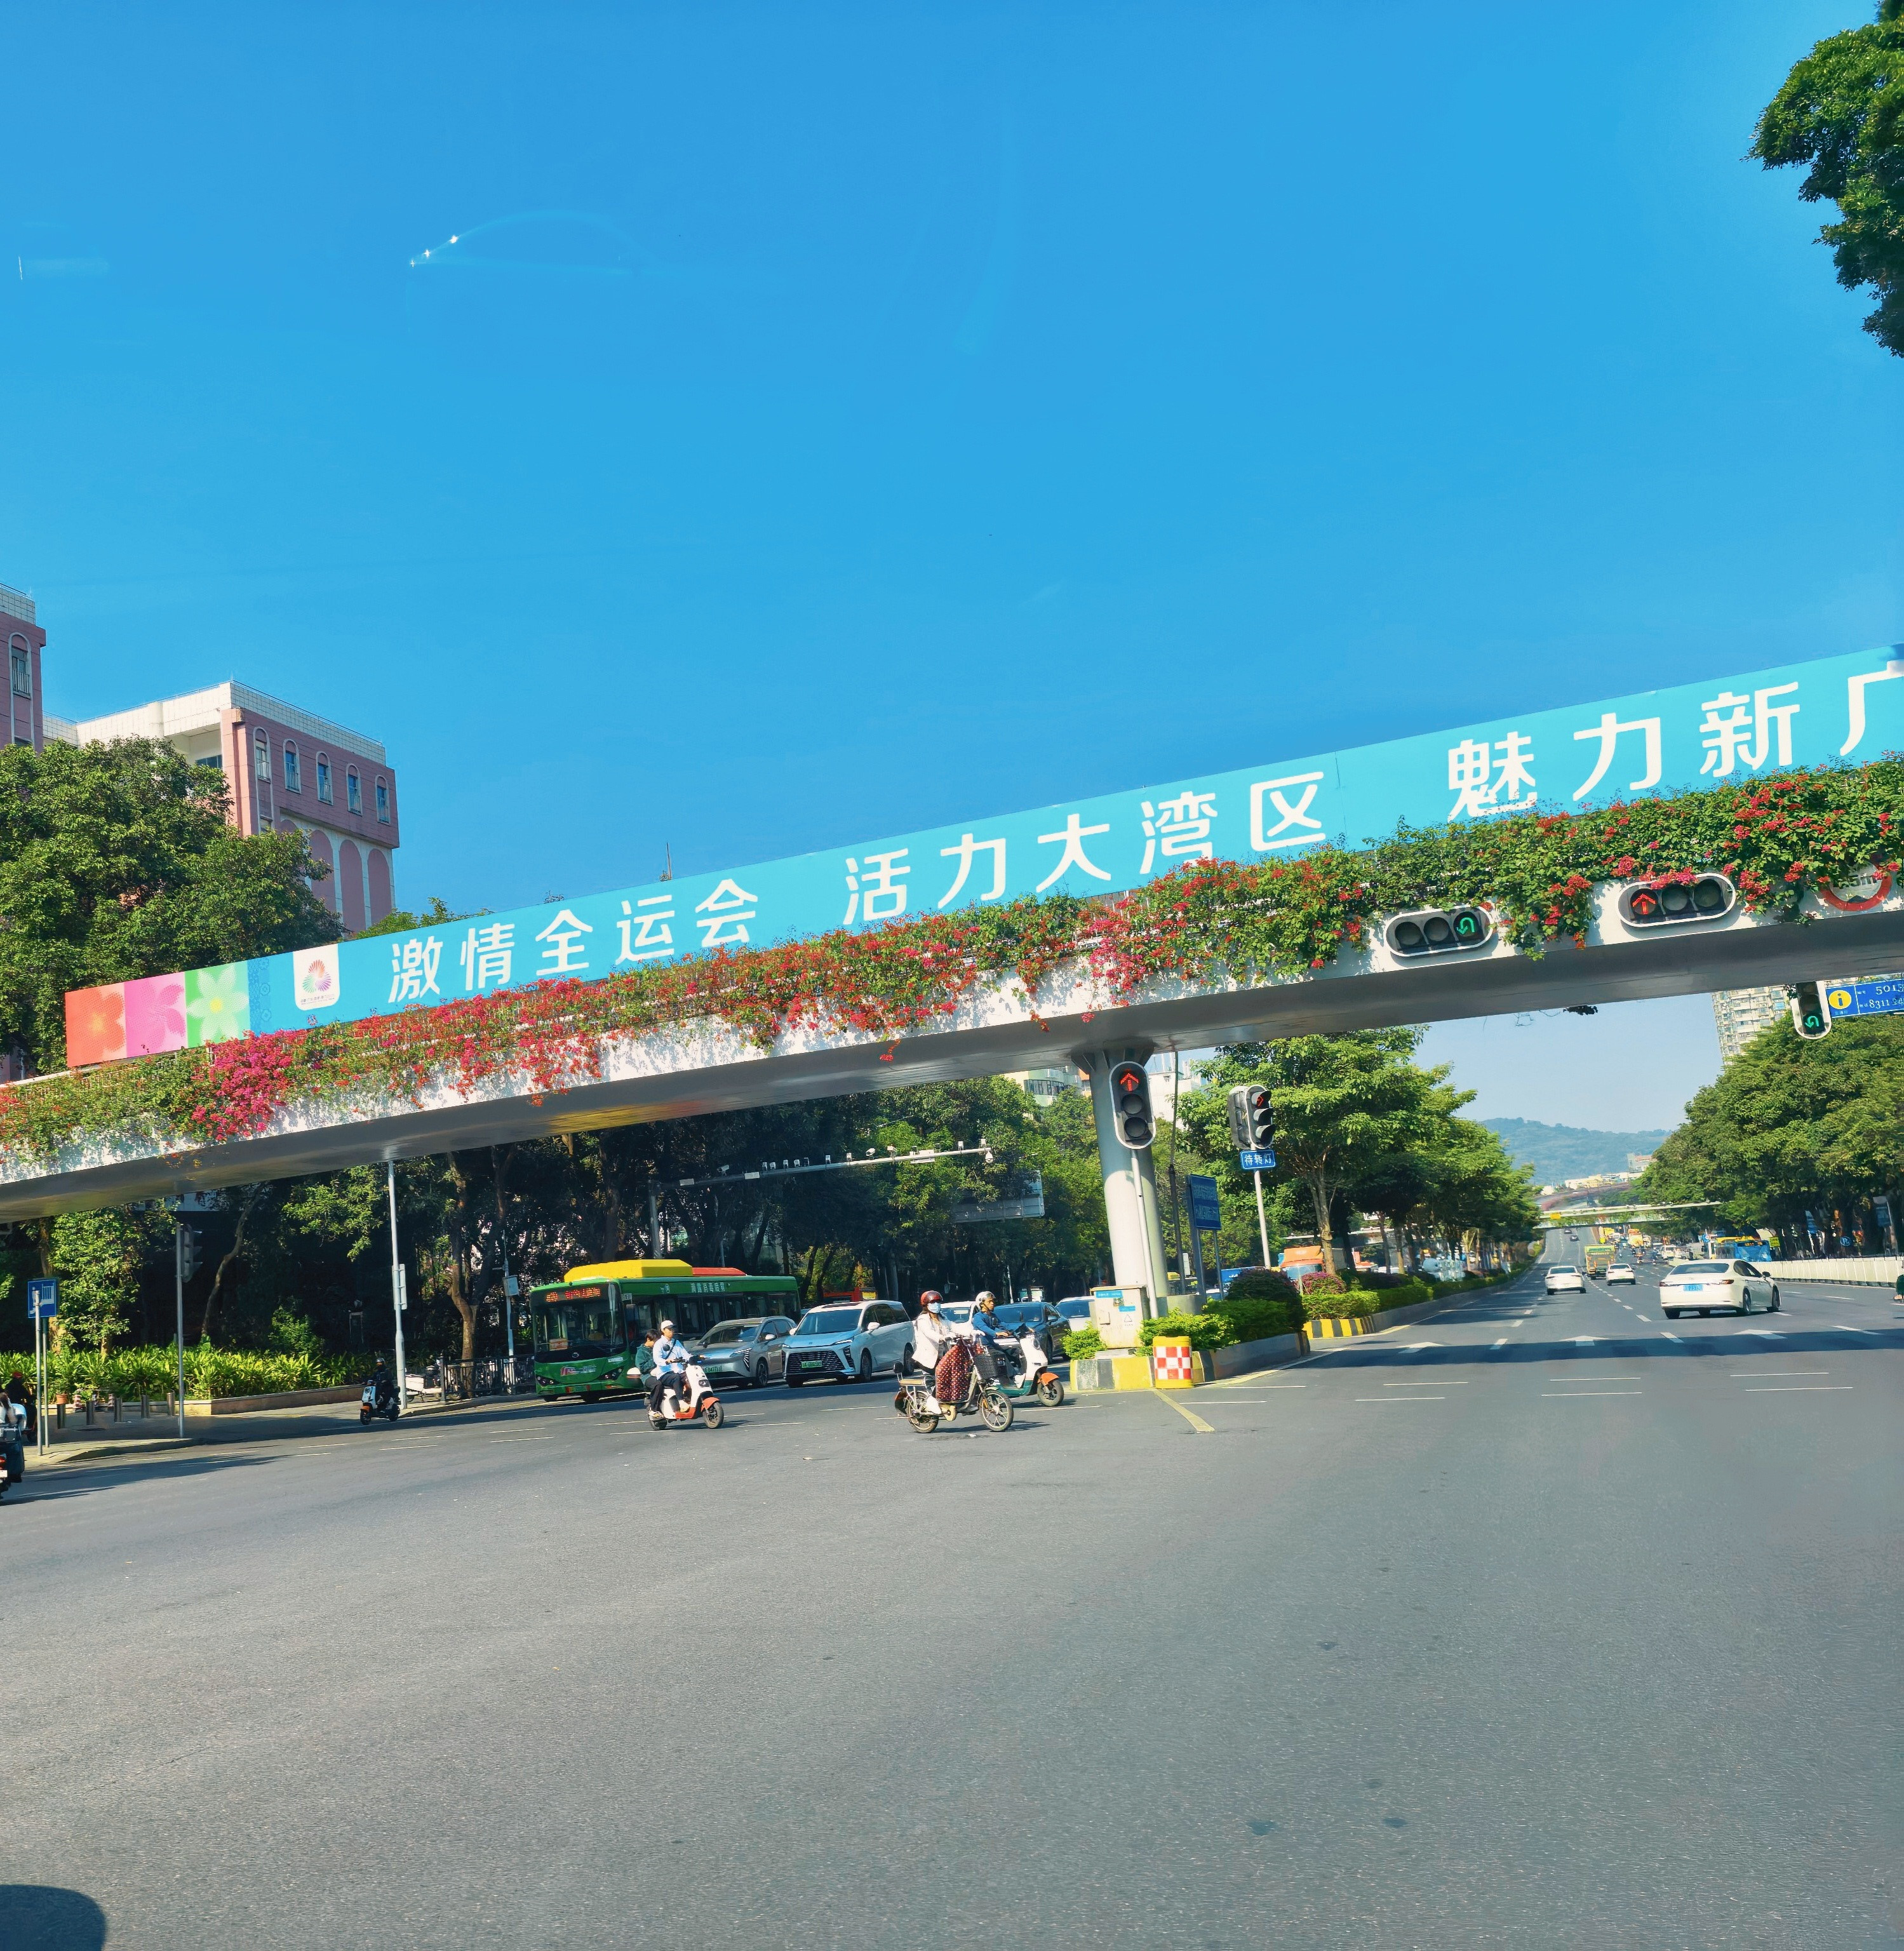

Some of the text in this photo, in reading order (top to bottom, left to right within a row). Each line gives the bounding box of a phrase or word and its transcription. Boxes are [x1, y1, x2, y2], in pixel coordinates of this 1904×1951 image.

[388, 879, 758, 1003] 激情全运会
[843, 771, 1326, 925] 活力大湾区
